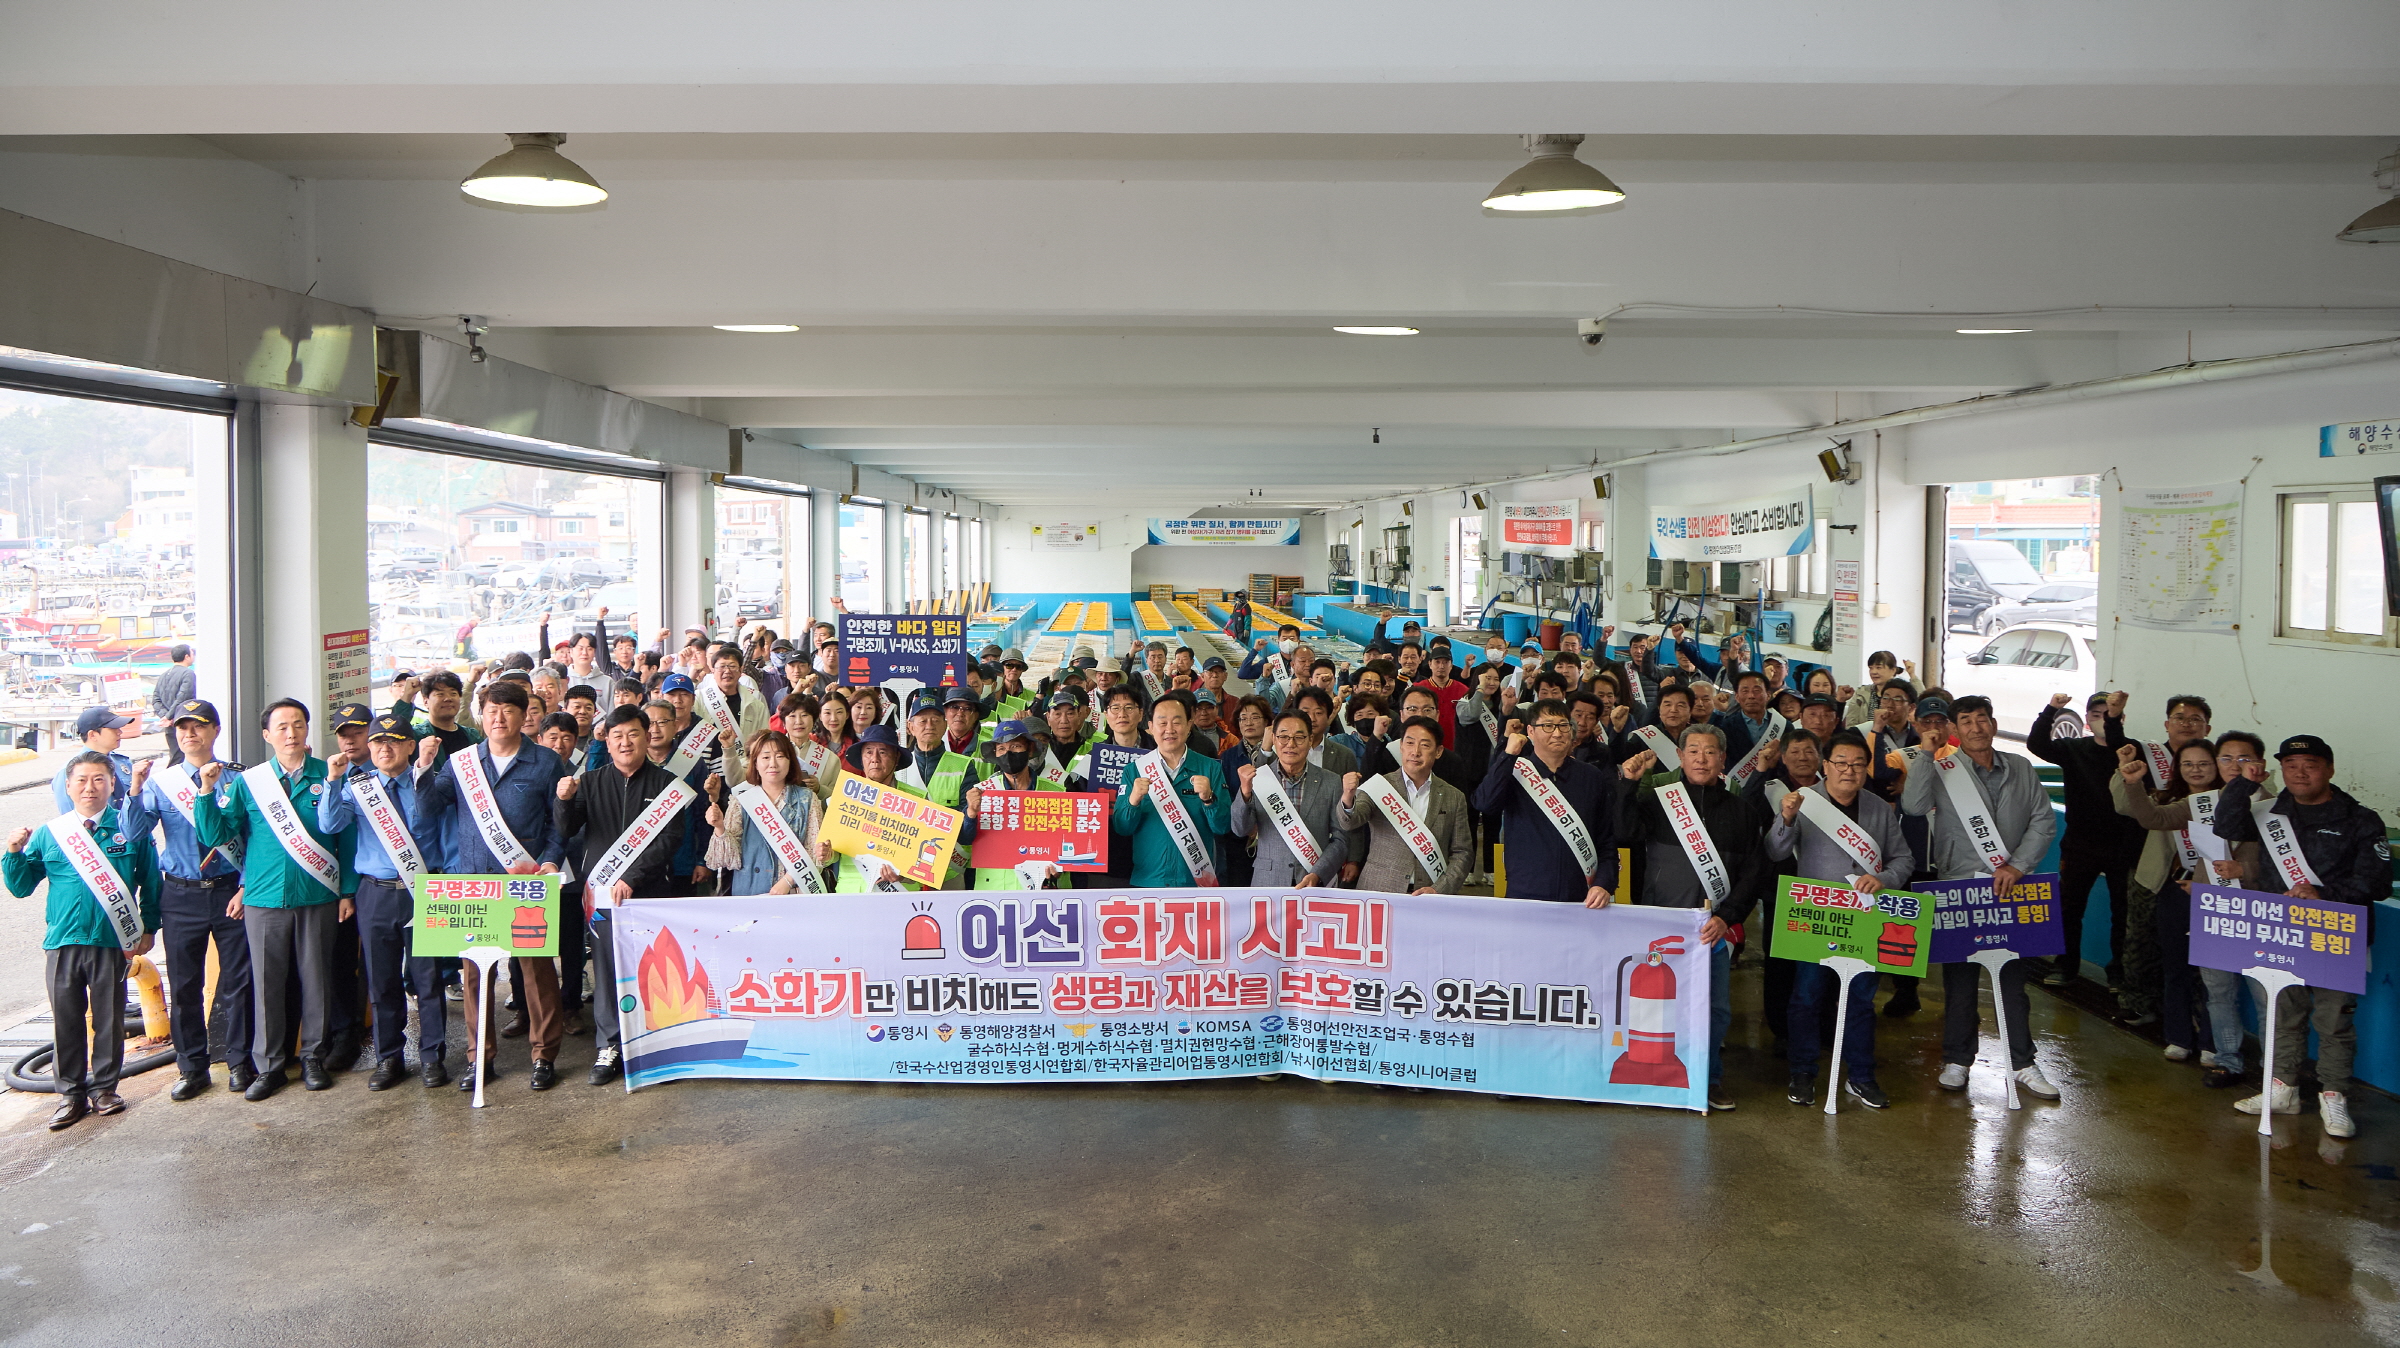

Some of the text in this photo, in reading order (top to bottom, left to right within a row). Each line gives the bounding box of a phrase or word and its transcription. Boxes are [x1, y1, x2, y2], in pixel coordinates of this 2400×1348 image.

[1165, 520, 1188, 528] 공정한
[1229, 520, 1245, 528] 함께
[1657, 501, 1804, 538] 우리 수산물 안전 이상없다! 안심하고 소비합시다!
[846, 619, 961, 636] 안전한 바다 일터
[846, 637, 961, 655] 구명조끼, V-PASS, 소화기
[899, 665, 919, 674] 통영시
[366, 793, 381, 808] 전
[458, 752, 514, 854] 어선사고 예방의 지름길
[844, 779, 954, 832] 어선 화재 사고
[980, 795, 1102, 816] 출항 전 안전점검 필수
[1514, 760, 1593, 862] 어선사고 예방의 지름길
[839, 802, 920, 838] 소화기를 비치하여
[979, 813, 1101, 833] 출항 후 안전수칙 준수
[1145, 762, 1203, 865] 어선사고 예방의 지름길
[268, 800, 288, 822] 출항
[281, 821, 296, 836] 전
[289, 835, 328, 872] 안전점검
[373, 806, 407, 850] 안전점검
[596, 789, 684, 886] 어선사고 예방의 지름길
[754, 802, 787, 843] 어선사고
[781, 842, 808, 872] 예방의
[840, 815, 912, 850] 미리 예방합시다.
[1279, 813, 1294, 827] 전
[1288, 825, 1320, 866] 안전점검
[1381, 793, 1439, 865] 어선사고 예방의
[1665, 789, 1694, 830] 어선사고
[1686, 830, 1713, 866] 예방의
[1969, 815, 1998, 853] 출항 전
[876, 844, 897, 857] 통영시
[1029, 846, 1050, 855] 통영시
[1836, 824, 1879, 865] 어선사고
[2276, 842, 2292, 856] 전
[398, 848, 419, 872] 필수
[2283, 856, 2310, 885] 안전
[66, 832, 102, 873] 어선사고
[94, 871, 124, 906] 예방의
[114, 904, 138, 938] 지름길
[426, 880, 547, 901] 구명조끼 착용
[1966, 886, 1994, 906] 어선
[1999, 882, 2052, 903] 전점검
[426, 904, 488, 915] 선택이 아닌
[1788, 907, 1854, 926] 선택이 아닌
[1877, 894, 1921, 918] 착용
[1973, 908, 2014, 928] 무사고
[2017, 904, 2050, 924] 통영!
[2200, 893, 2357, 933] 오늘의 어선 안전점검
[426, 917, 487, 928] 필수입니다.
[961, 899, 1389, 967] 어선 화재 사고!
[1787, 920, 1852, 939] 필수입니다.
[476, 933, 499, 942] 통영시
[1985, 934, 2008, 945] 통영시
[2203, 916, 2351, 955] 내일의 무사고 통영!
[1839, 943, 1863, 954] 통영시
[2267, 953, 2295, 966] 통영시
[728, 970, 1598, 1027] 소화기만 비치해도 생명과 재산을 보호할 수 있습니다.
[887, 1026, 928, 1041] 통영시
[960, 1023, 1055, 1040] 통영해양경찰서
[1100, 1021, 1168, 1037] 통영소방서
[1196, 1020, 1252, 1033] KOMSA
